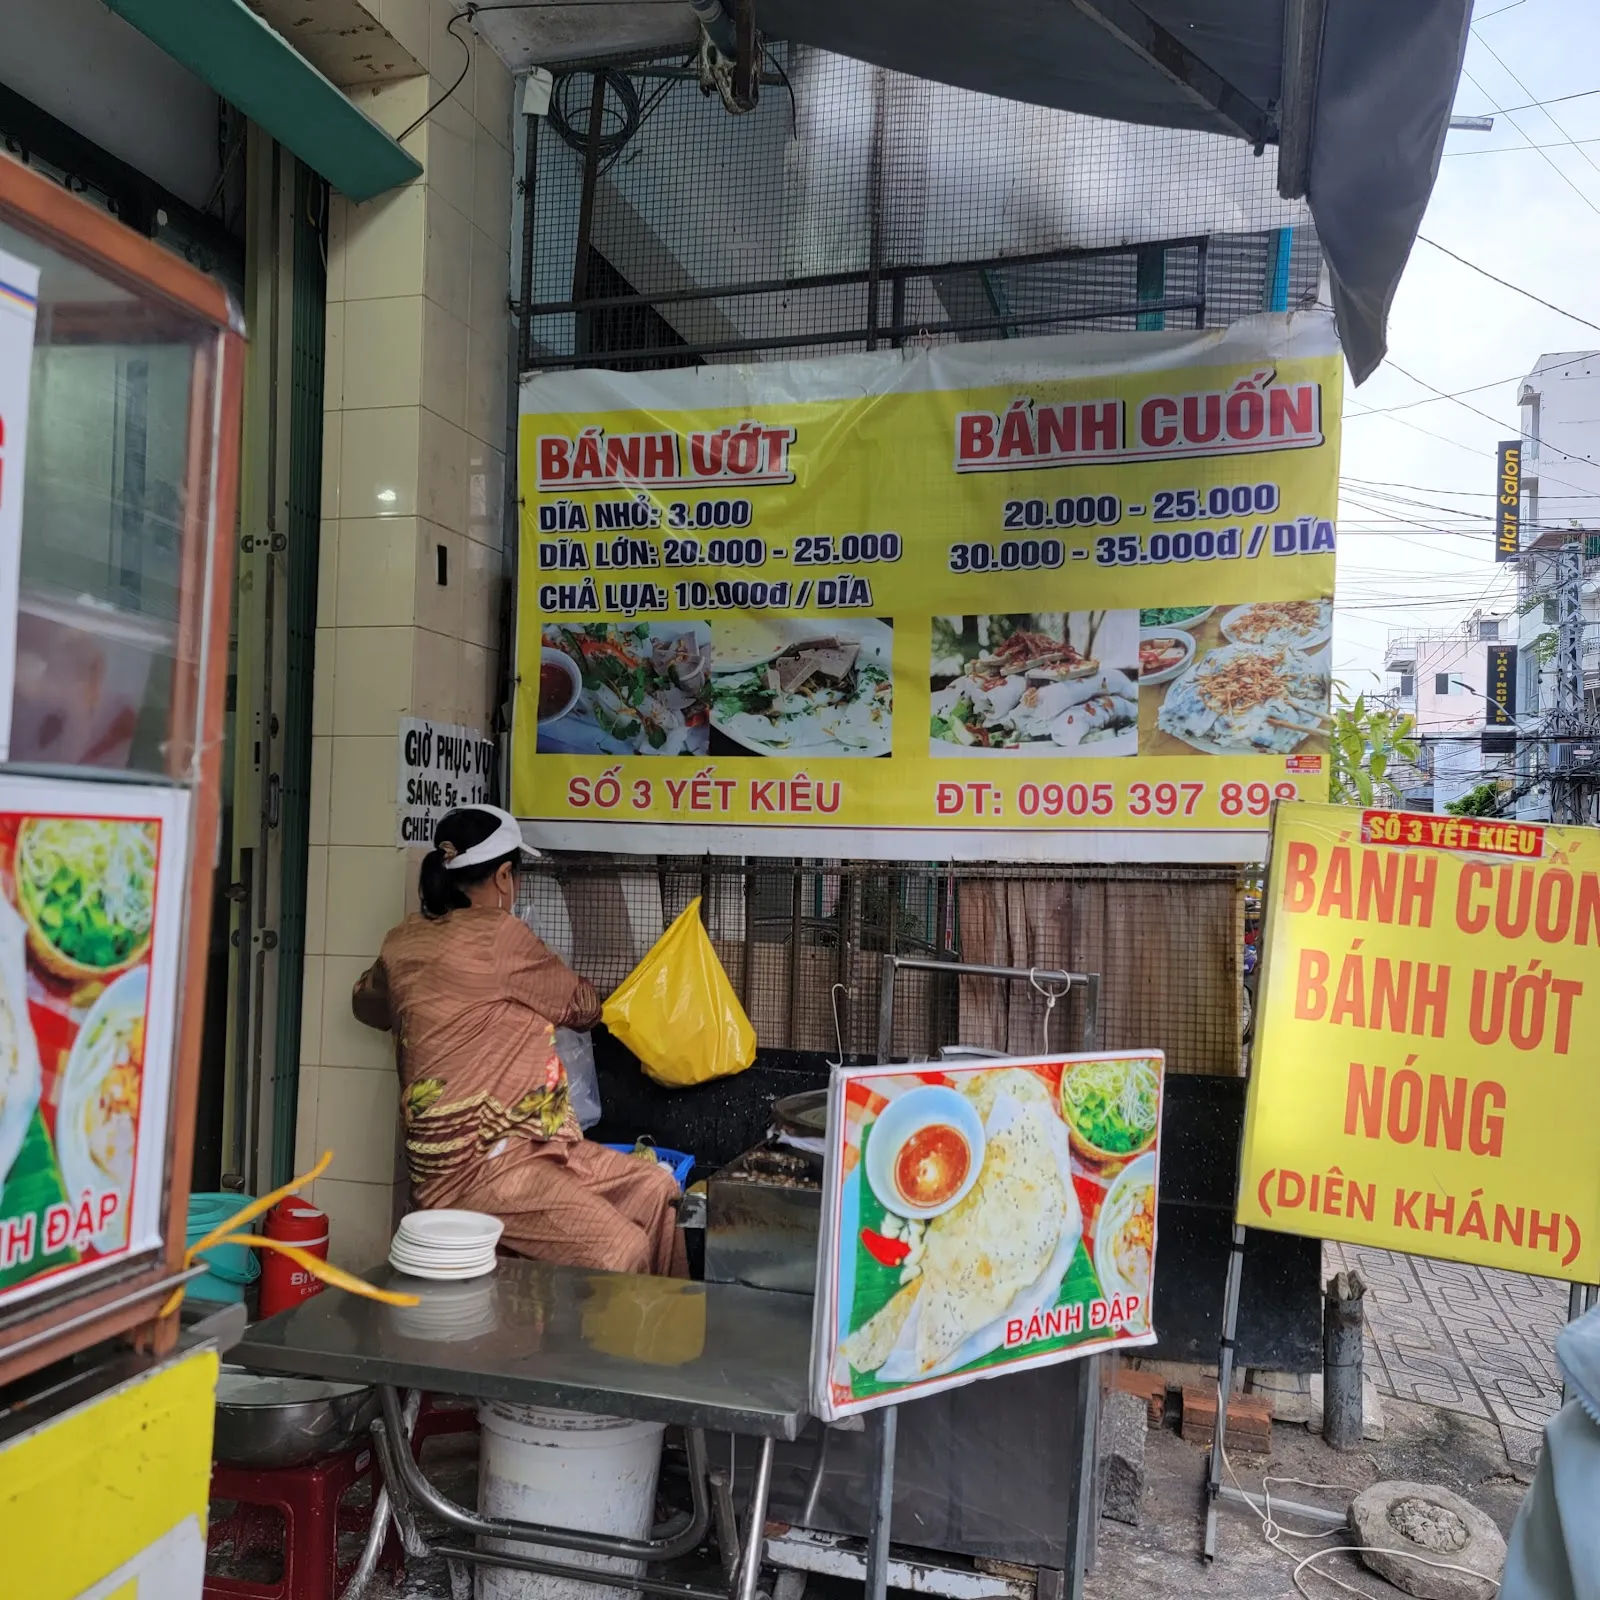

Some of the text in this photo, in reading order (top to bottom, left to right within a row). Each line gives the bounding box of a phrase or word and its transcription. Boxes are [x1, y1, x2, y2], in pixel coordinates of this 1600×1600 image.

[960, 372, 1314, 460] BÁNH CUỐN
[540, 421, 790, 481] BÁNH ƯỚT
[540, 494, 750, 531] DĨA NHỎ: 3.000
[1004, 484, 1278, 528] 20.000 - 25.000
[1500, 449, 1519, 552] Har Salon
[540, 535, 900, 569] DĨA LỚN: 20.000 - 25.000
[950, 519, 1335, 571] 30.000 - 35.000đ / DĨA
[540, 574, 871, 615] CHẢ LỤA: 10.000đ / DĨA
[405, 723, 490, 782] GIỜ PHỤC VỤ
[407, 773, 442, 808] SÁNG:
[445, 783, 458, 808] 5g
[568, 766, 840, 812] SỐ 3 YẾT KIÊU
[936, 783, 1001, 815] ĐT:
[1018, 783, 1113, 816] 0905
[1129, 783, 1203, 816] 397
[1408, 820, 1422, 843] 3
[1430, 817, 1474, 848] YẾT
[1478, 825, 1536, 854] KIÊU
[1282, 831, 1439, 928] BÁNH
[1294, 938, 1583, 1055] BÁNH ƯỚT
[1343, 1054, 1507, 1158] NÓNG
[47, 1189, 118, 1249] ĐẬP
[1258, 1165, 1581, 1267] (DIÊN KHÁNH)
[1006, 1292, 1140, 1345] BÁNH ĐẬP
